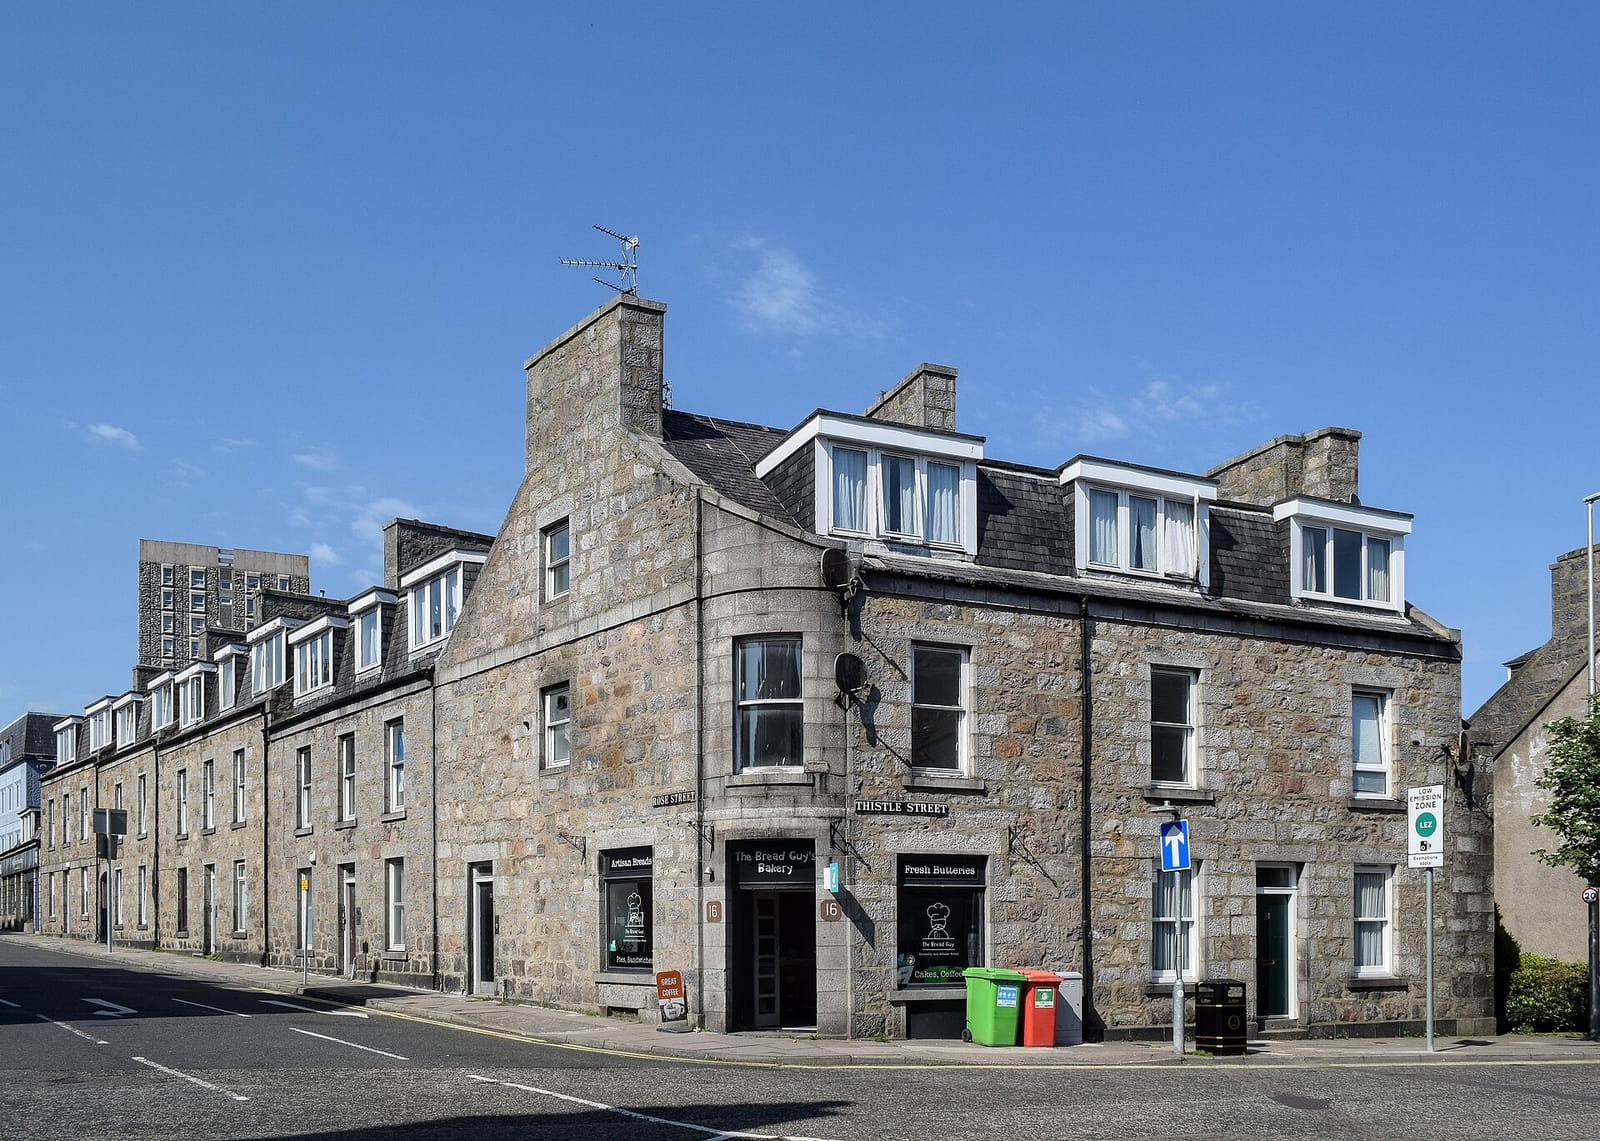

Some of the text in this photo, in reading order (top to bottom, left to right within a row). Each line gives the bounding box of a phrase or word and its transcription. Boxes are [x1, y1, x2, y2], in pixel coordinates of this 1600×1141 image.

[652, 791, 695, 806] ROSE STREET
[1409, 794, 1442, 802] EMISSION
[856, 801, 948, 814] THISTLE STREET
[1415, 801, 1437, 810] ZONE
[1419, 821, 1433, 829] LEZ
[611, 857, 652, 868] Artisan Breads
[735, 851, 816, 863] The Bread Guy's
[758, 863, 793, 875] Bakery
[904, 864, 976, 875] Fresh Butteries
[1584, 892, 1596, 900] 20
[709, 904, 718, 918] 16
[826, 902, 838, 916] 16
[914, 970, 939, 979] Cakes,
[661, 977, 677, 985] GREAT
